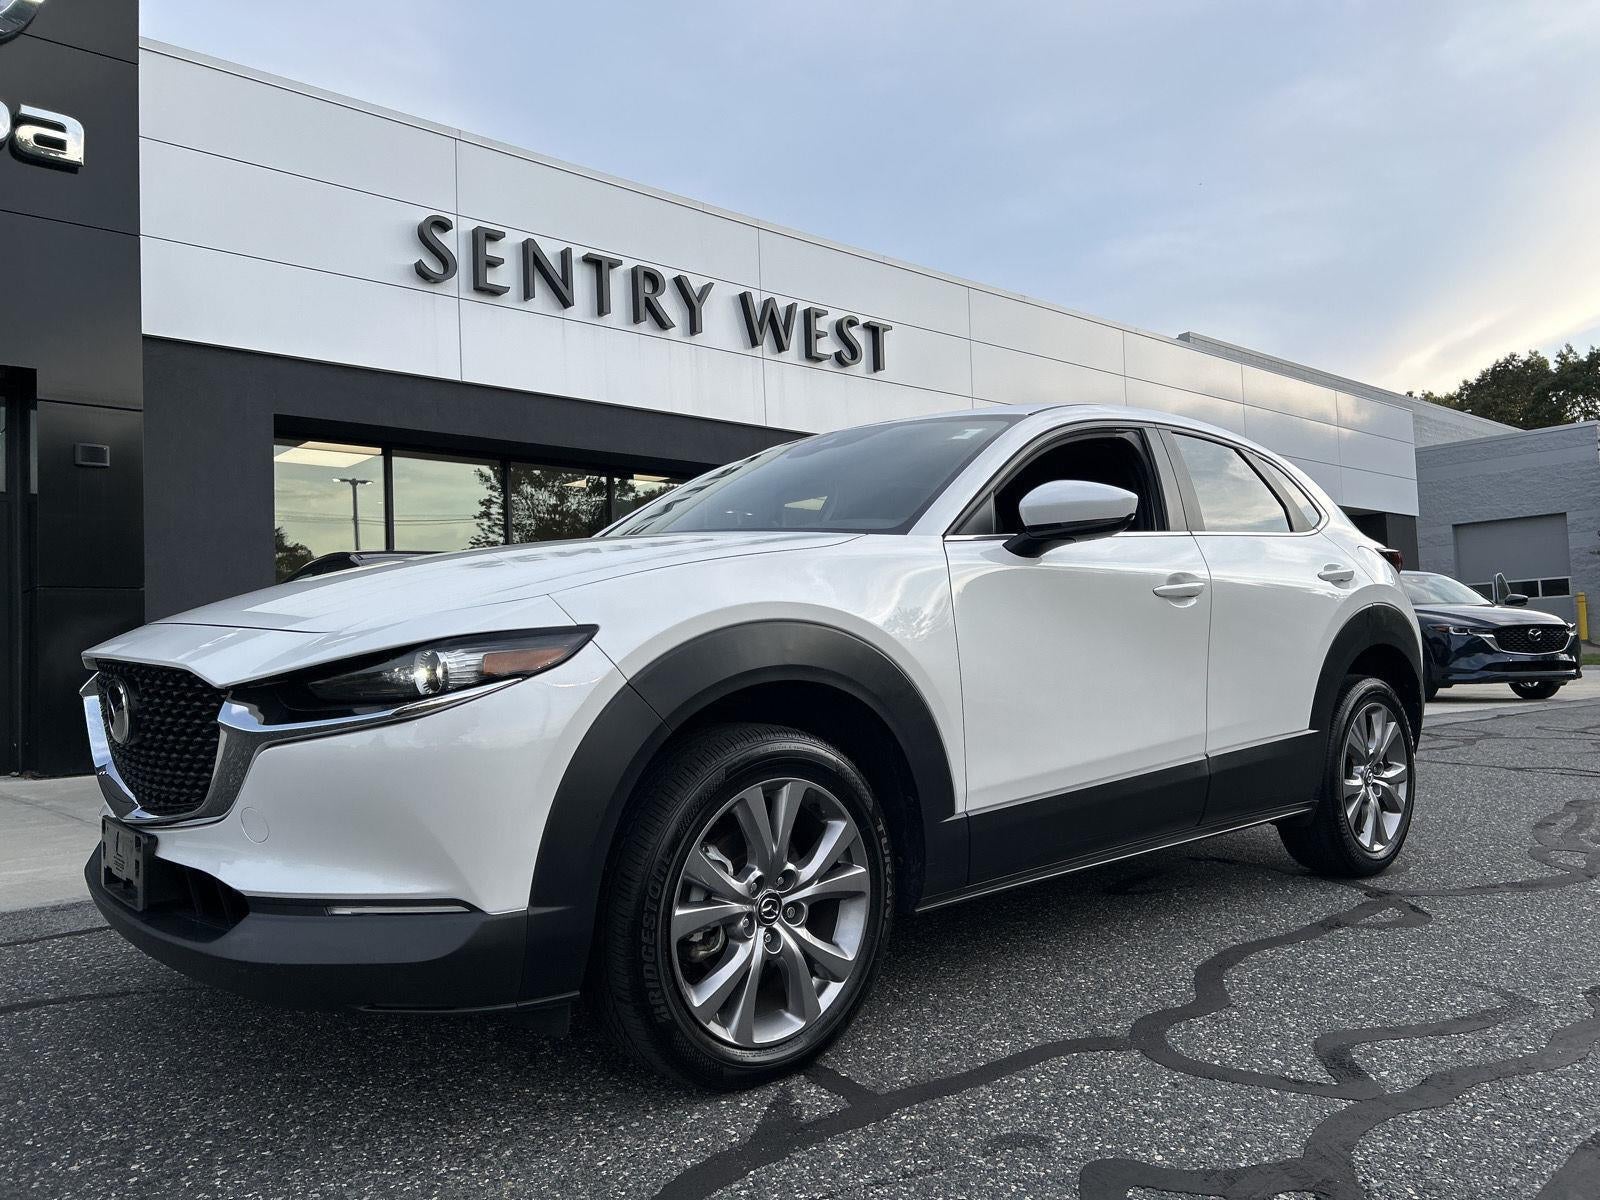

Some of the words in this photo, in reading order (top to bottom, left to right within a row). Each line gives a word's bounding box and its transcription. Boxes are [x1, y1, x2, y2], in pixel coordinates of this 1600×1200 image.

[0, 102, 85, 168] a
[414, 214, 714, 336] SENTRY
[738, 290, 893, 372] WEST
